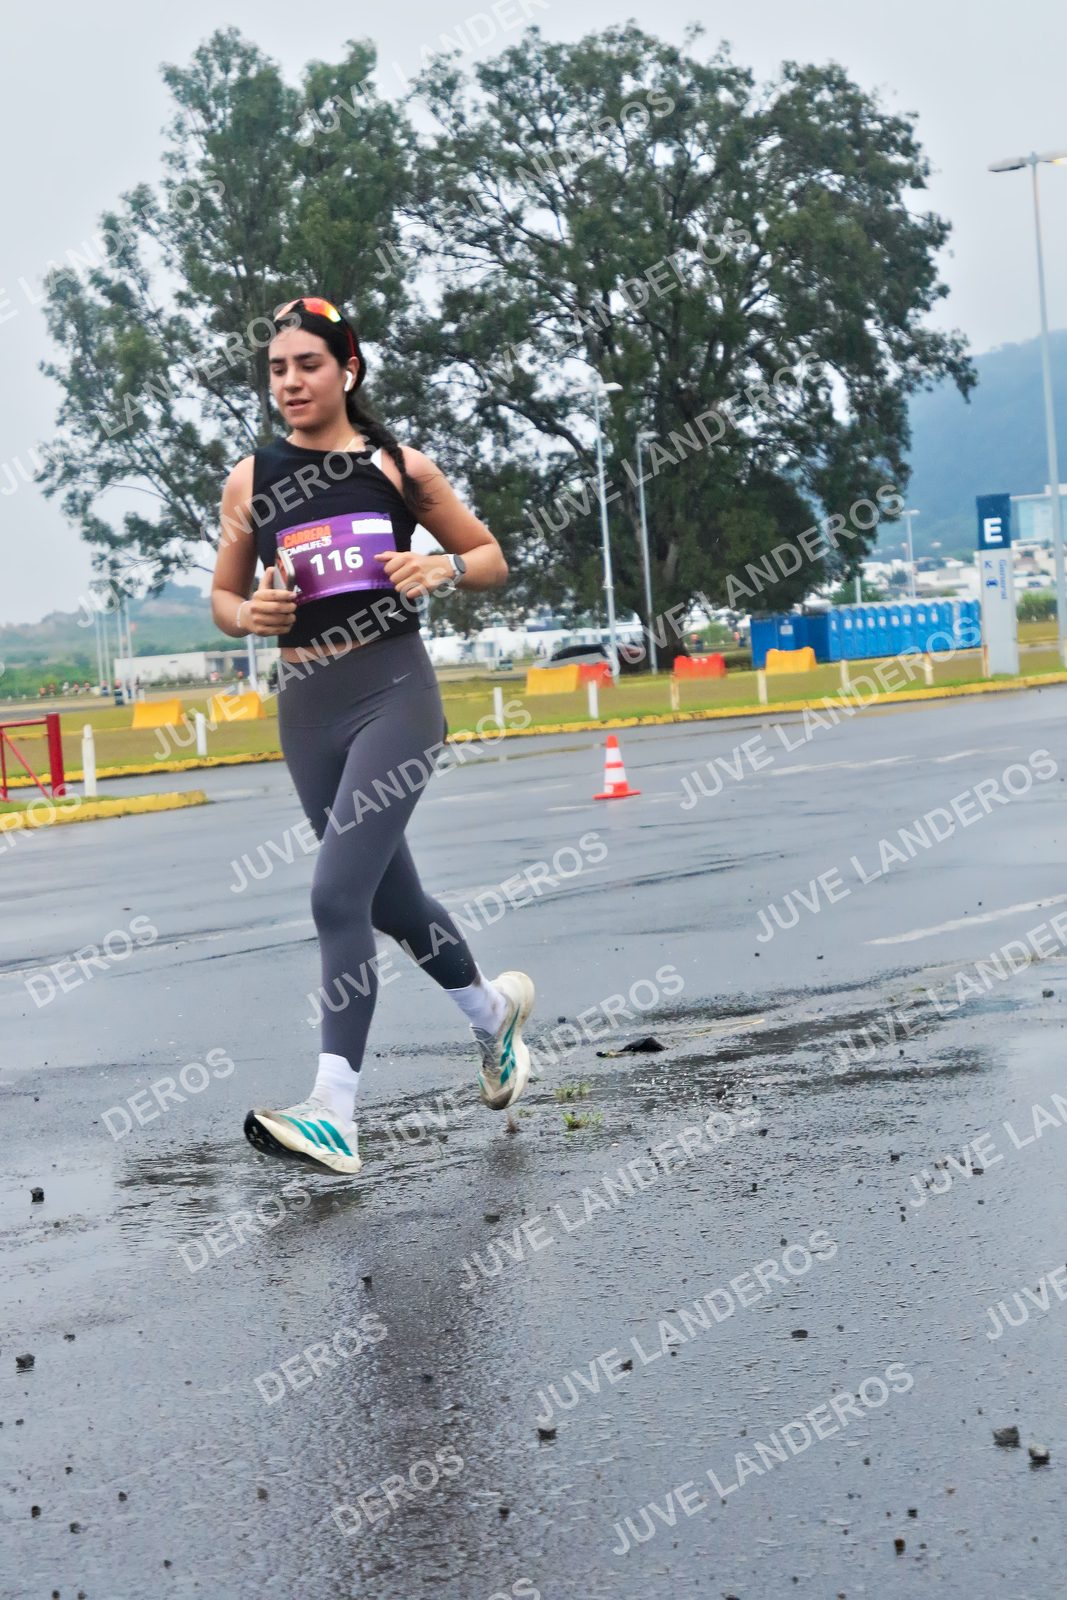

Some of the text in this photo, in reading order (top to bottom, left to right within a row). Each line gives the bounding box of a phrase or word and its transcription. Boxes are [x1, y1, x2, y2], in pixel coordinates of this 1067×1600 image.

[284, 525, 332, 548] CARRERA
[983, 517, 1003, 543] E
[310, 547, 364, 576] 116
